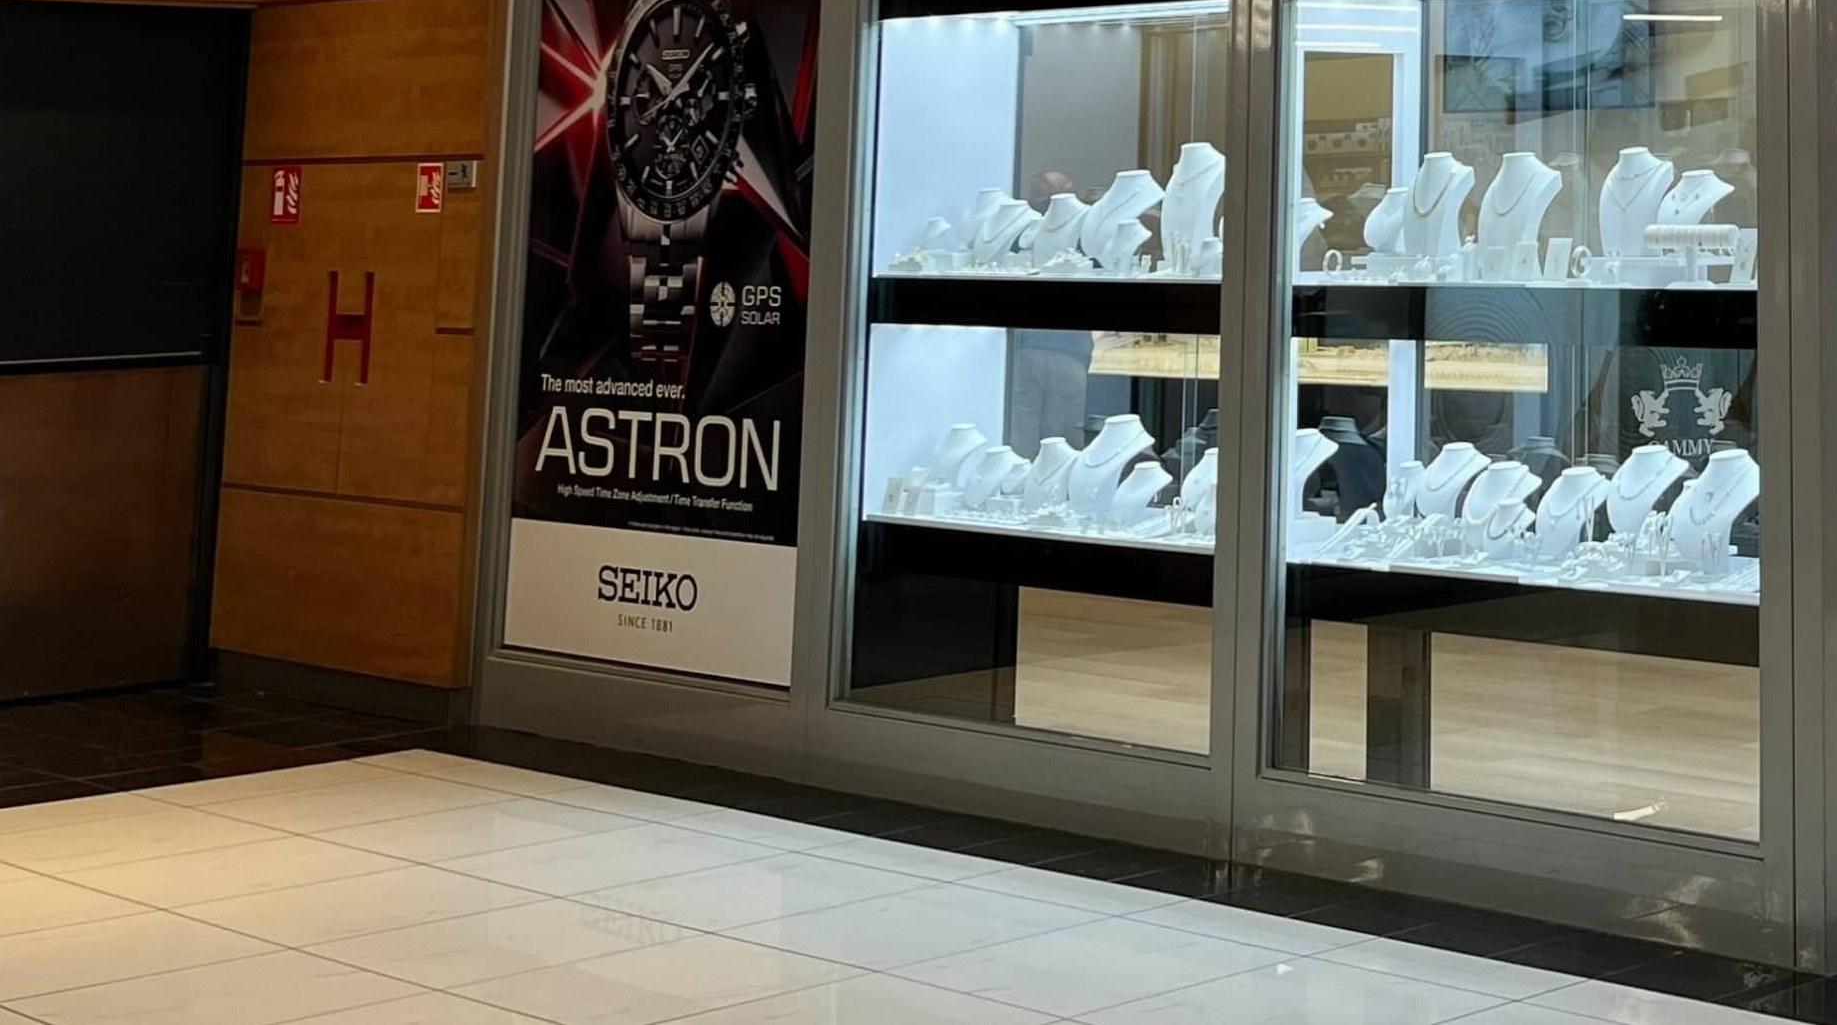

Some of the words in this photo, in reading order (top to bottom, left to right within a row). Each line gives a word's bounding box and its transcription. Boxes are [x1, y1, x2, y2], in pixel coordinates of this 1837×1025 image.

[742, 285, 782, 307] GPS
[741, 311, 781, 325] SOLAR
[541, 373, 562, 392] The
[564, 376, 593, 394] most
[596, 377, 653, 397] advanced
[656, 383, 686, 400] ever.
[535, 405, 781, 492] ASTRON
[557, 484, 573, 498] High
[596, 486, 612, 499] Time
[613, 488, 630, 501] Zone
[721, 497, 753, 512] Function
[598, 565, 698, 611] SEIKO
[617, 614, 647, 630] SINCE
